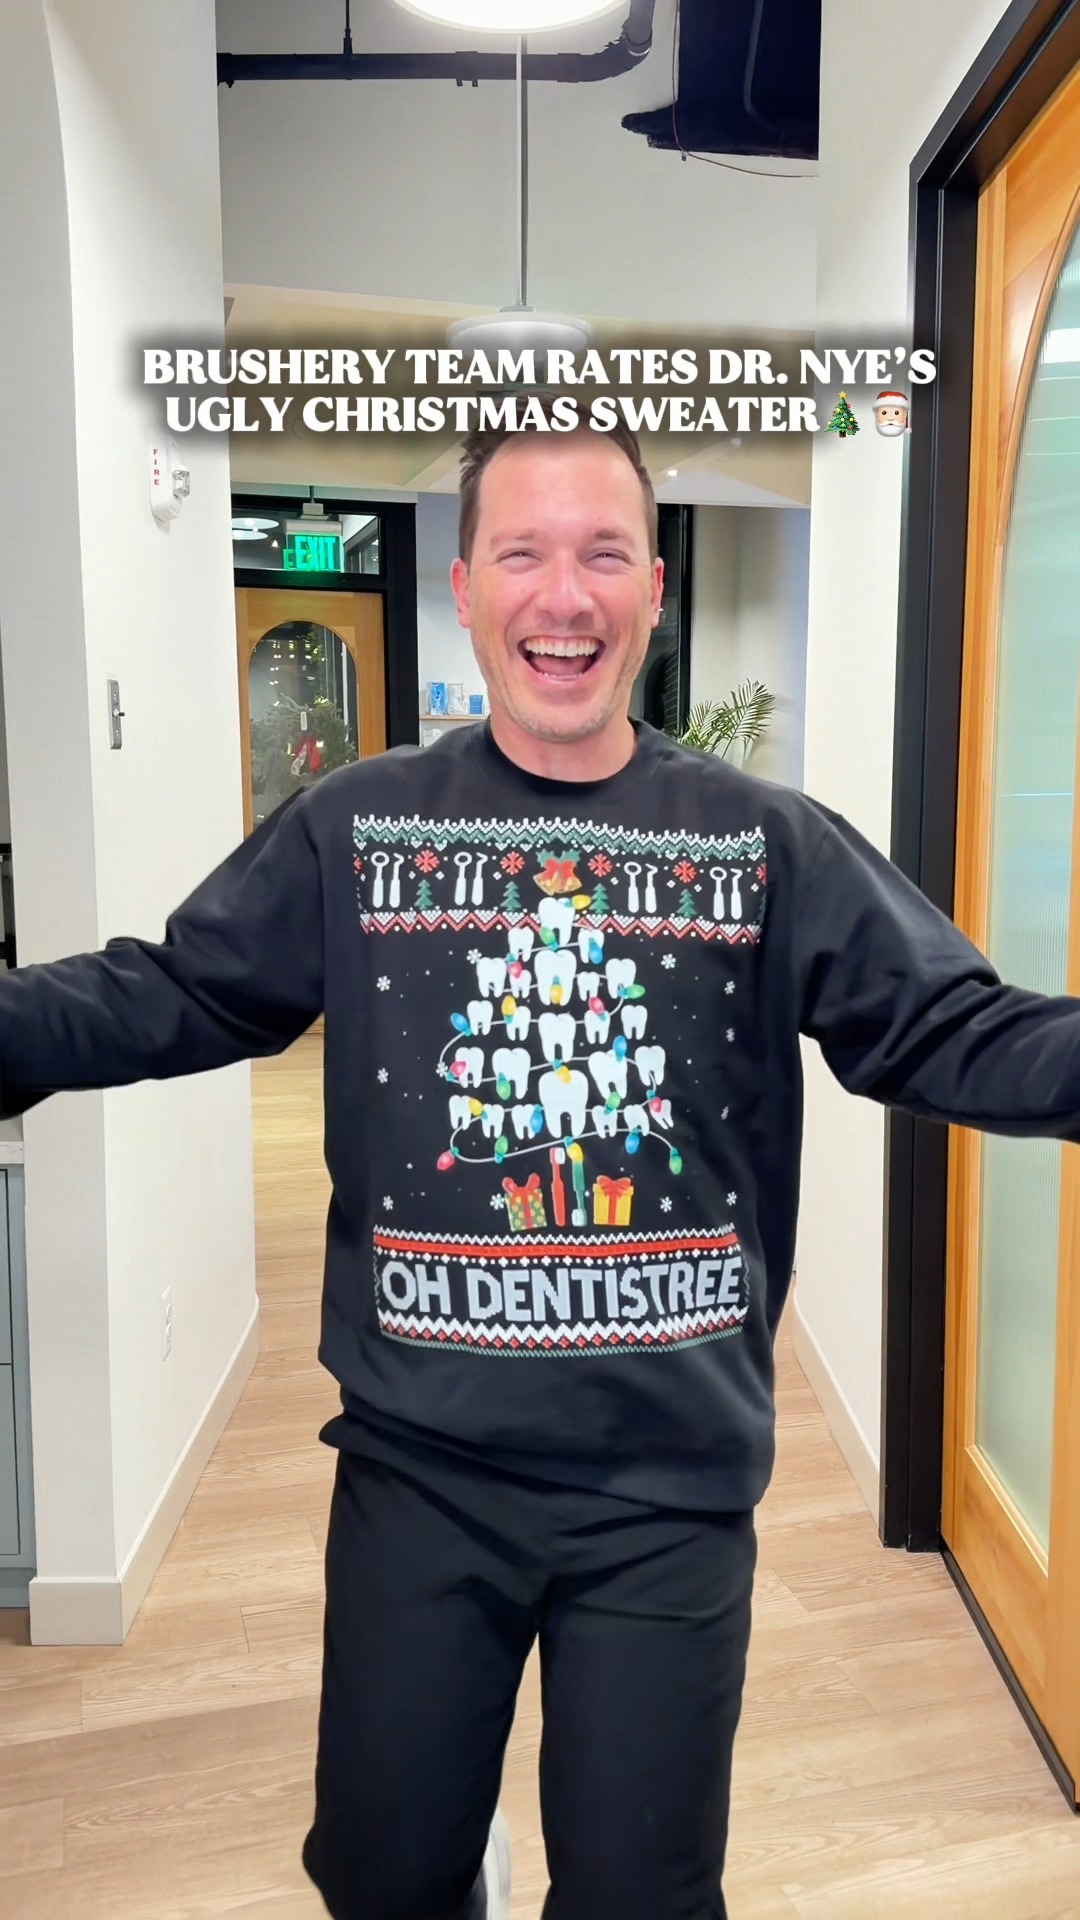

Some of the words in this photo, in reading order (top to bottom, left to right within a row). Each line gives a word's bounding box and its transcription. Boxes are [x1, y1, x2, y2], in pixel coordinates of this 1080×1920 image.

[153, 448, 161, 486] FIRE
[294, 535, 336, 570] EXIT
[381, 1260, 452, 1315] OH
[466, 1256, 743, 1322] DENTISTREE
